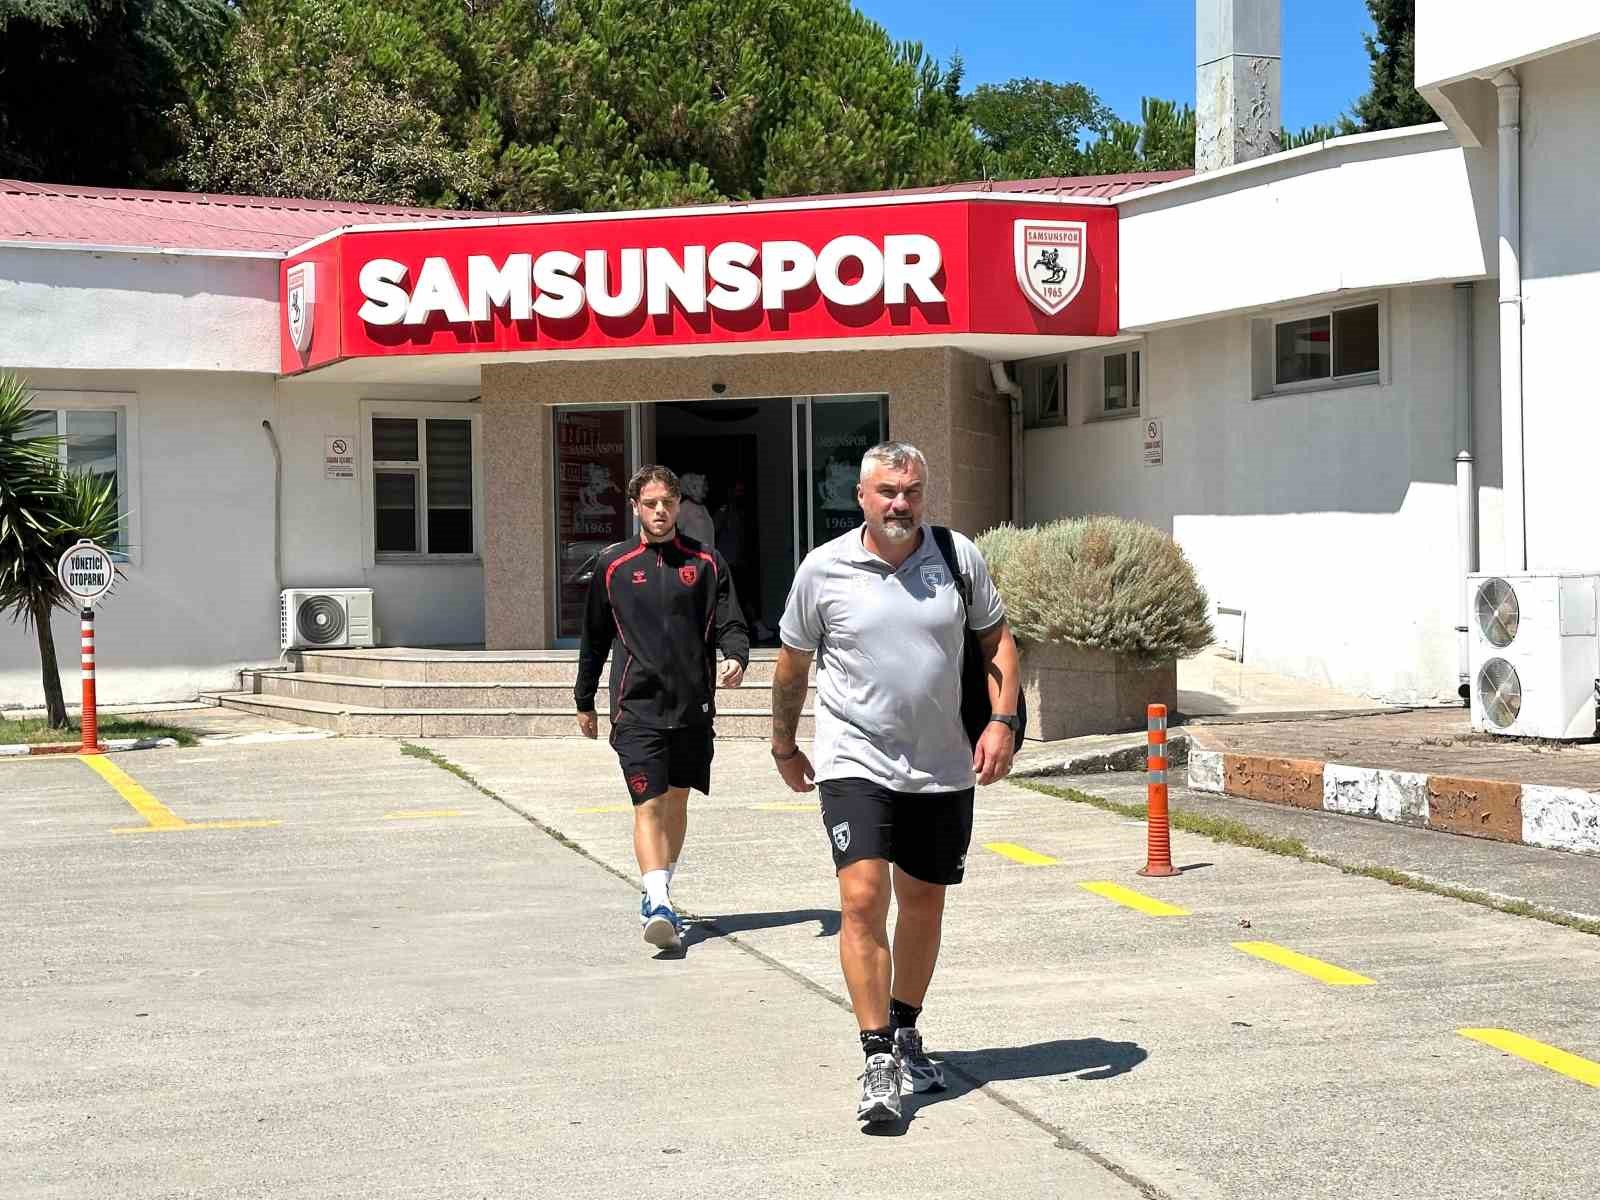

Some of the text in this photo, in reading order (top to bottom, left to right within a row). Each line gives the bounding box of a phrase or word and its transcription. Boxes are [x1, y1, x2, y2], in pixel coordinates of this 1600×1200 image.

[1028, 231, 1078, 241] SAMSUNSPOR
[357, 234, 946, 326] SAMSUNSPOR
[1043, 287, 1063, 297] 1965
[824, 516, 856, 529] 1965
[69, 573, 105, 586] OTOPARKI
